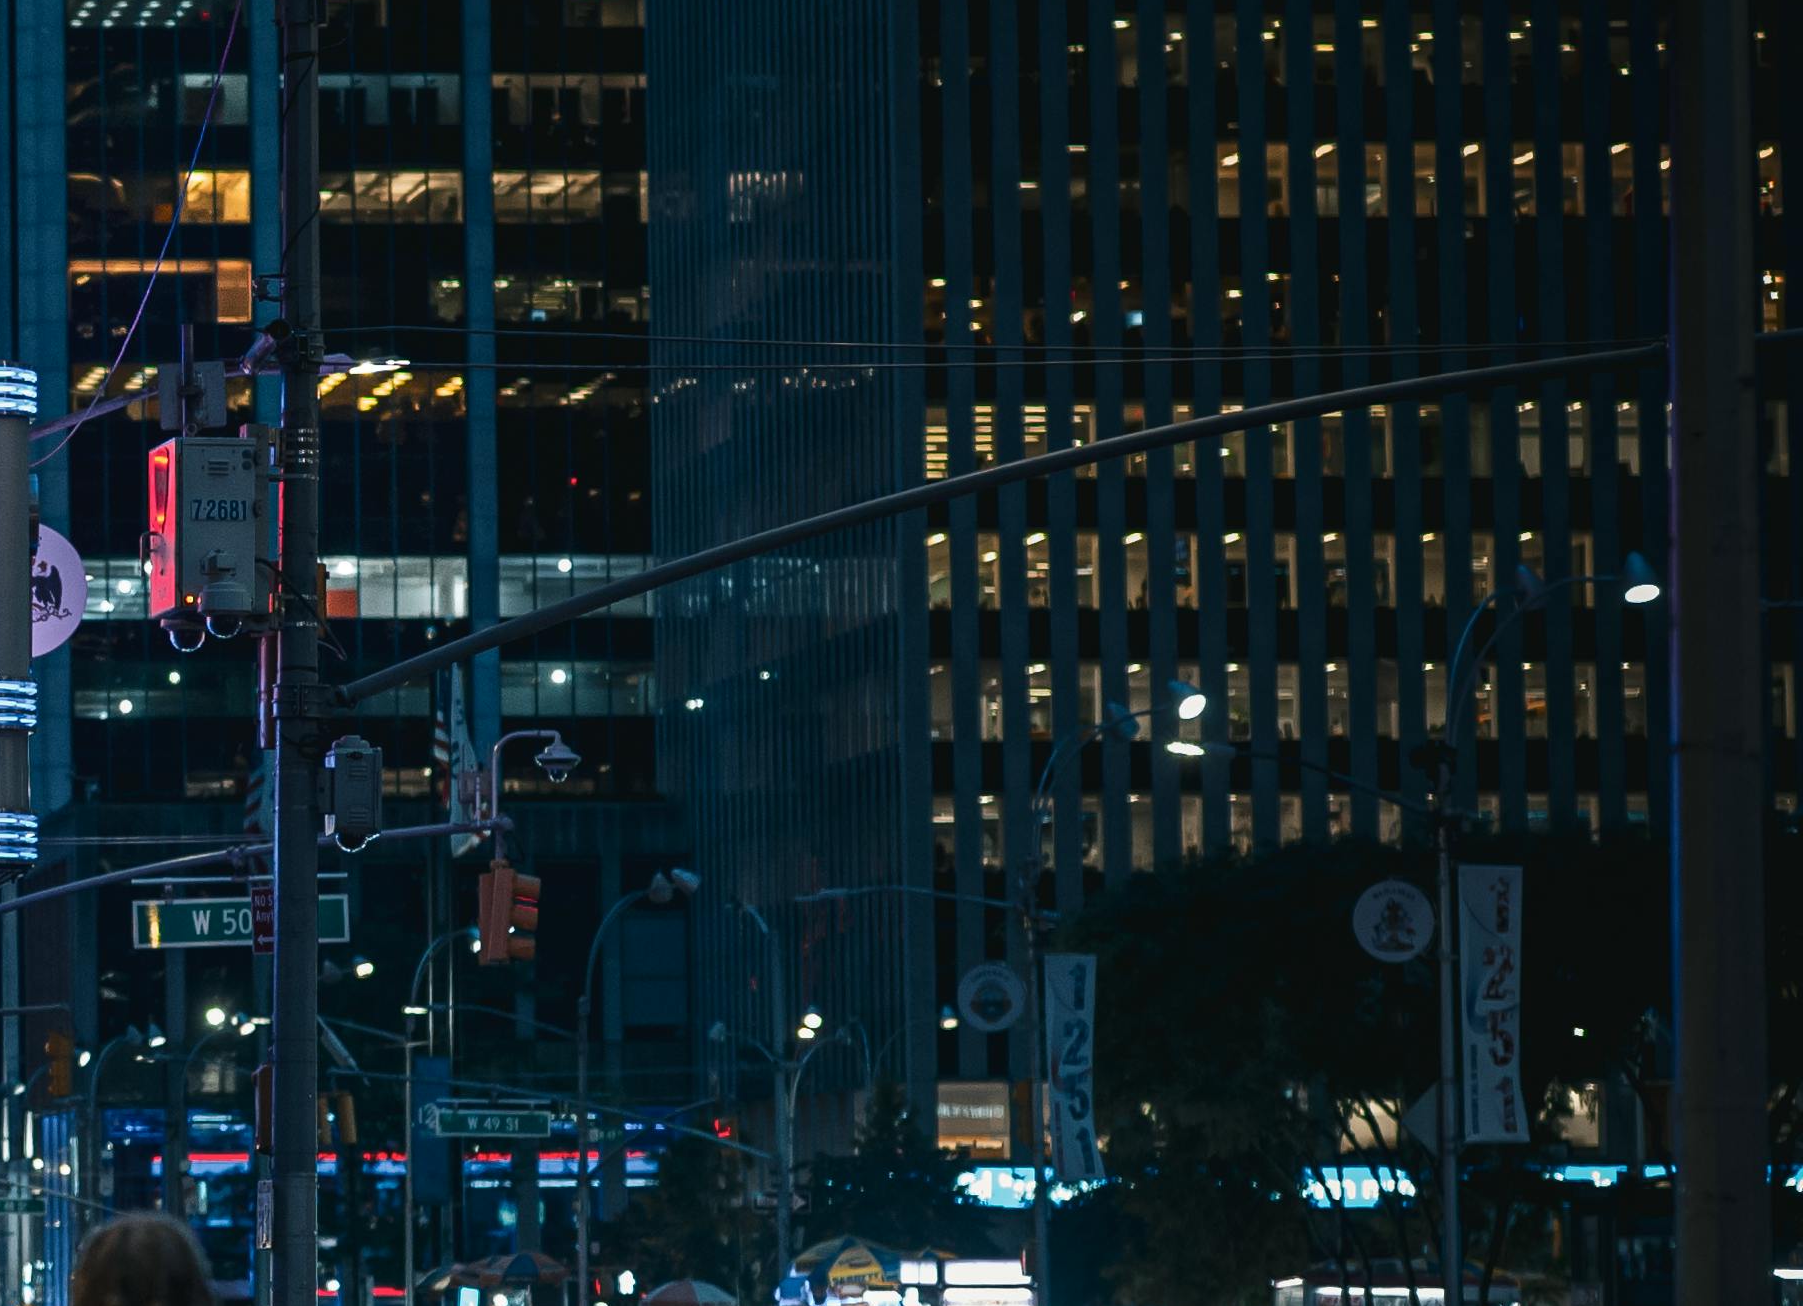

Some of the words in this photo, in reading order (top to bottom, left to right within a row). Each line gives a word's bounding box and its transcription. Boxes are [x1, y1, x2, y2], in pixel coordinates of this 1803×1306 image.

[192, 910, 212, 935] W
[222, 908, 252, 935] 50
[1062, 962, 1096, 1175] 1251
[467, 1117, 478, 1130] W
[483, 1117, 500, 1131] 49
